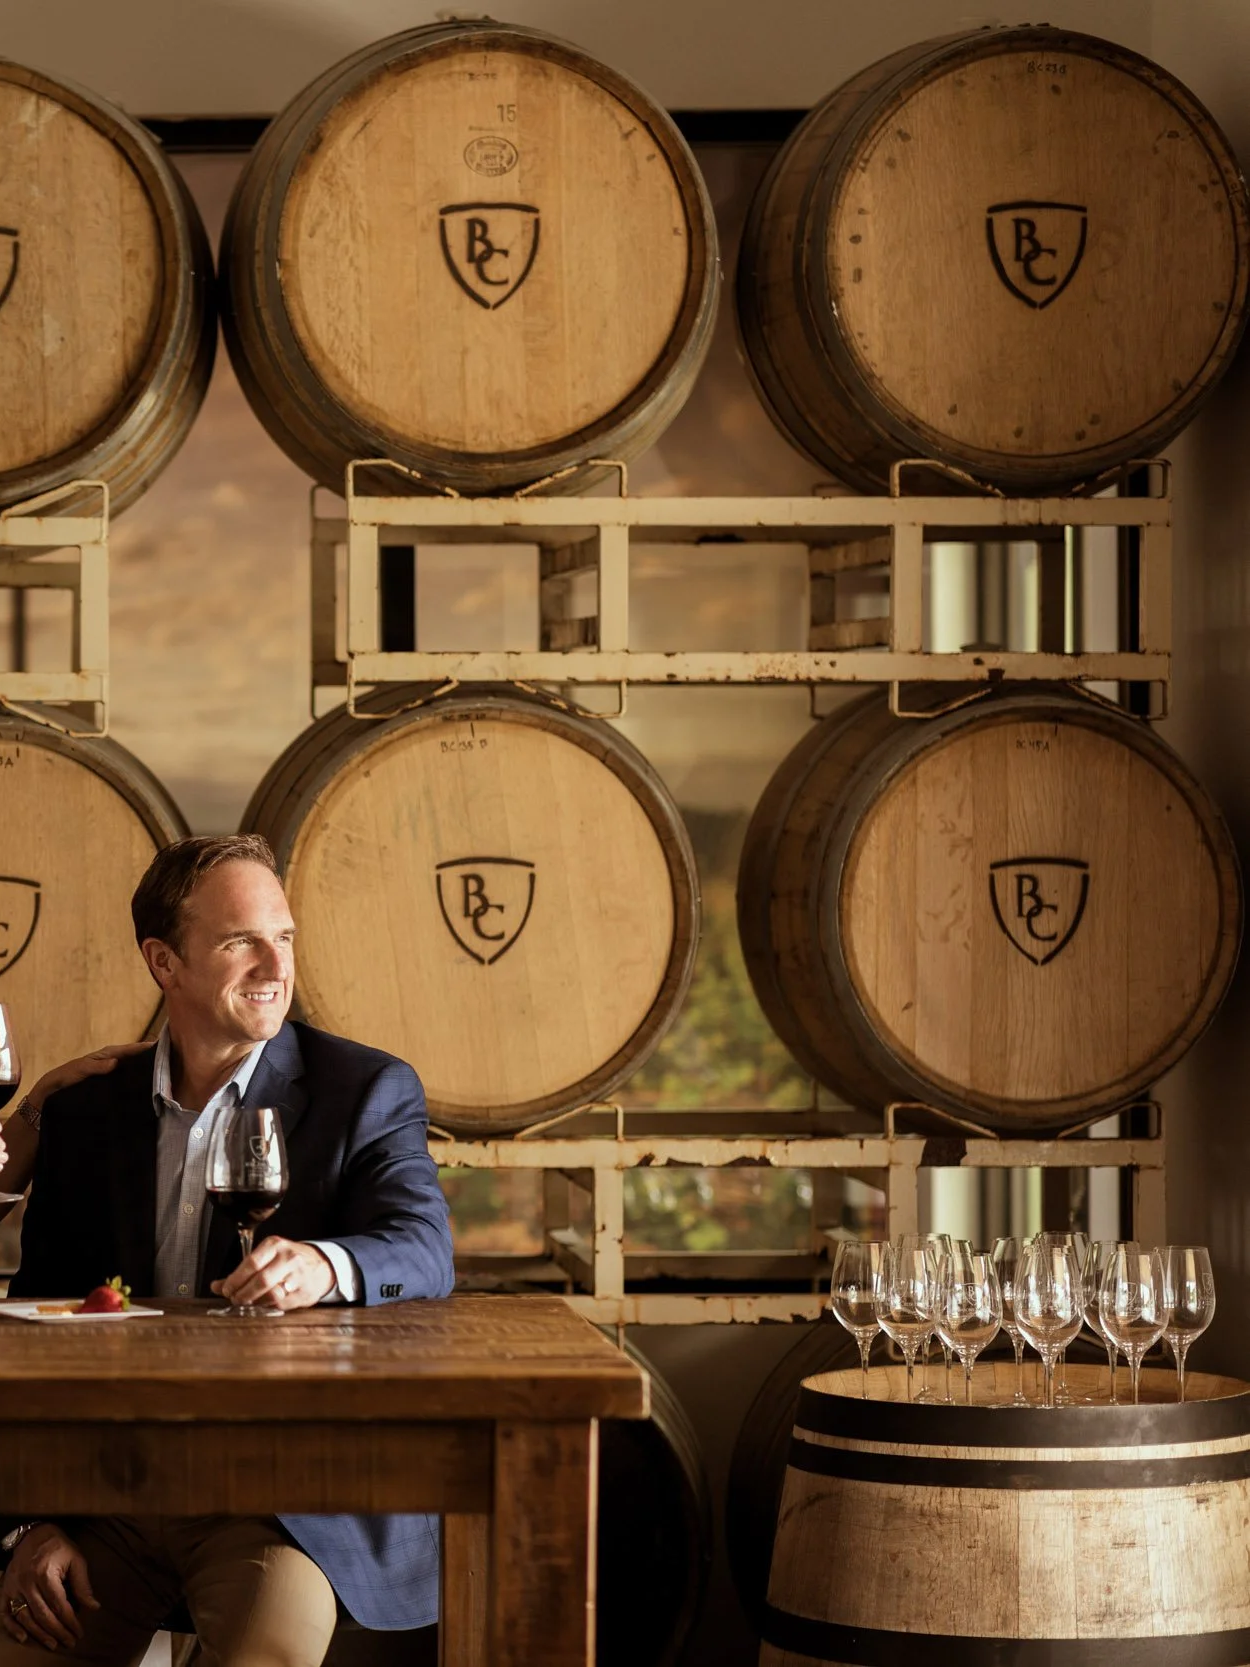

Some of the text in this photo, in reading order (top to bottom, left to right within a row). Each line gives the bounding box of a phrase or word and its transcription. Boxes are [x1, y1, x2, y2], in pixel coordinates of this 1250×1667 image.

[497, 104, 516, 122] 15
[466, 218, 508, 286] BC
[1013, 218, 1057, 286] BC
[461, 874, 505, 941] BC
[1016, 874, 1057, 941] BC
